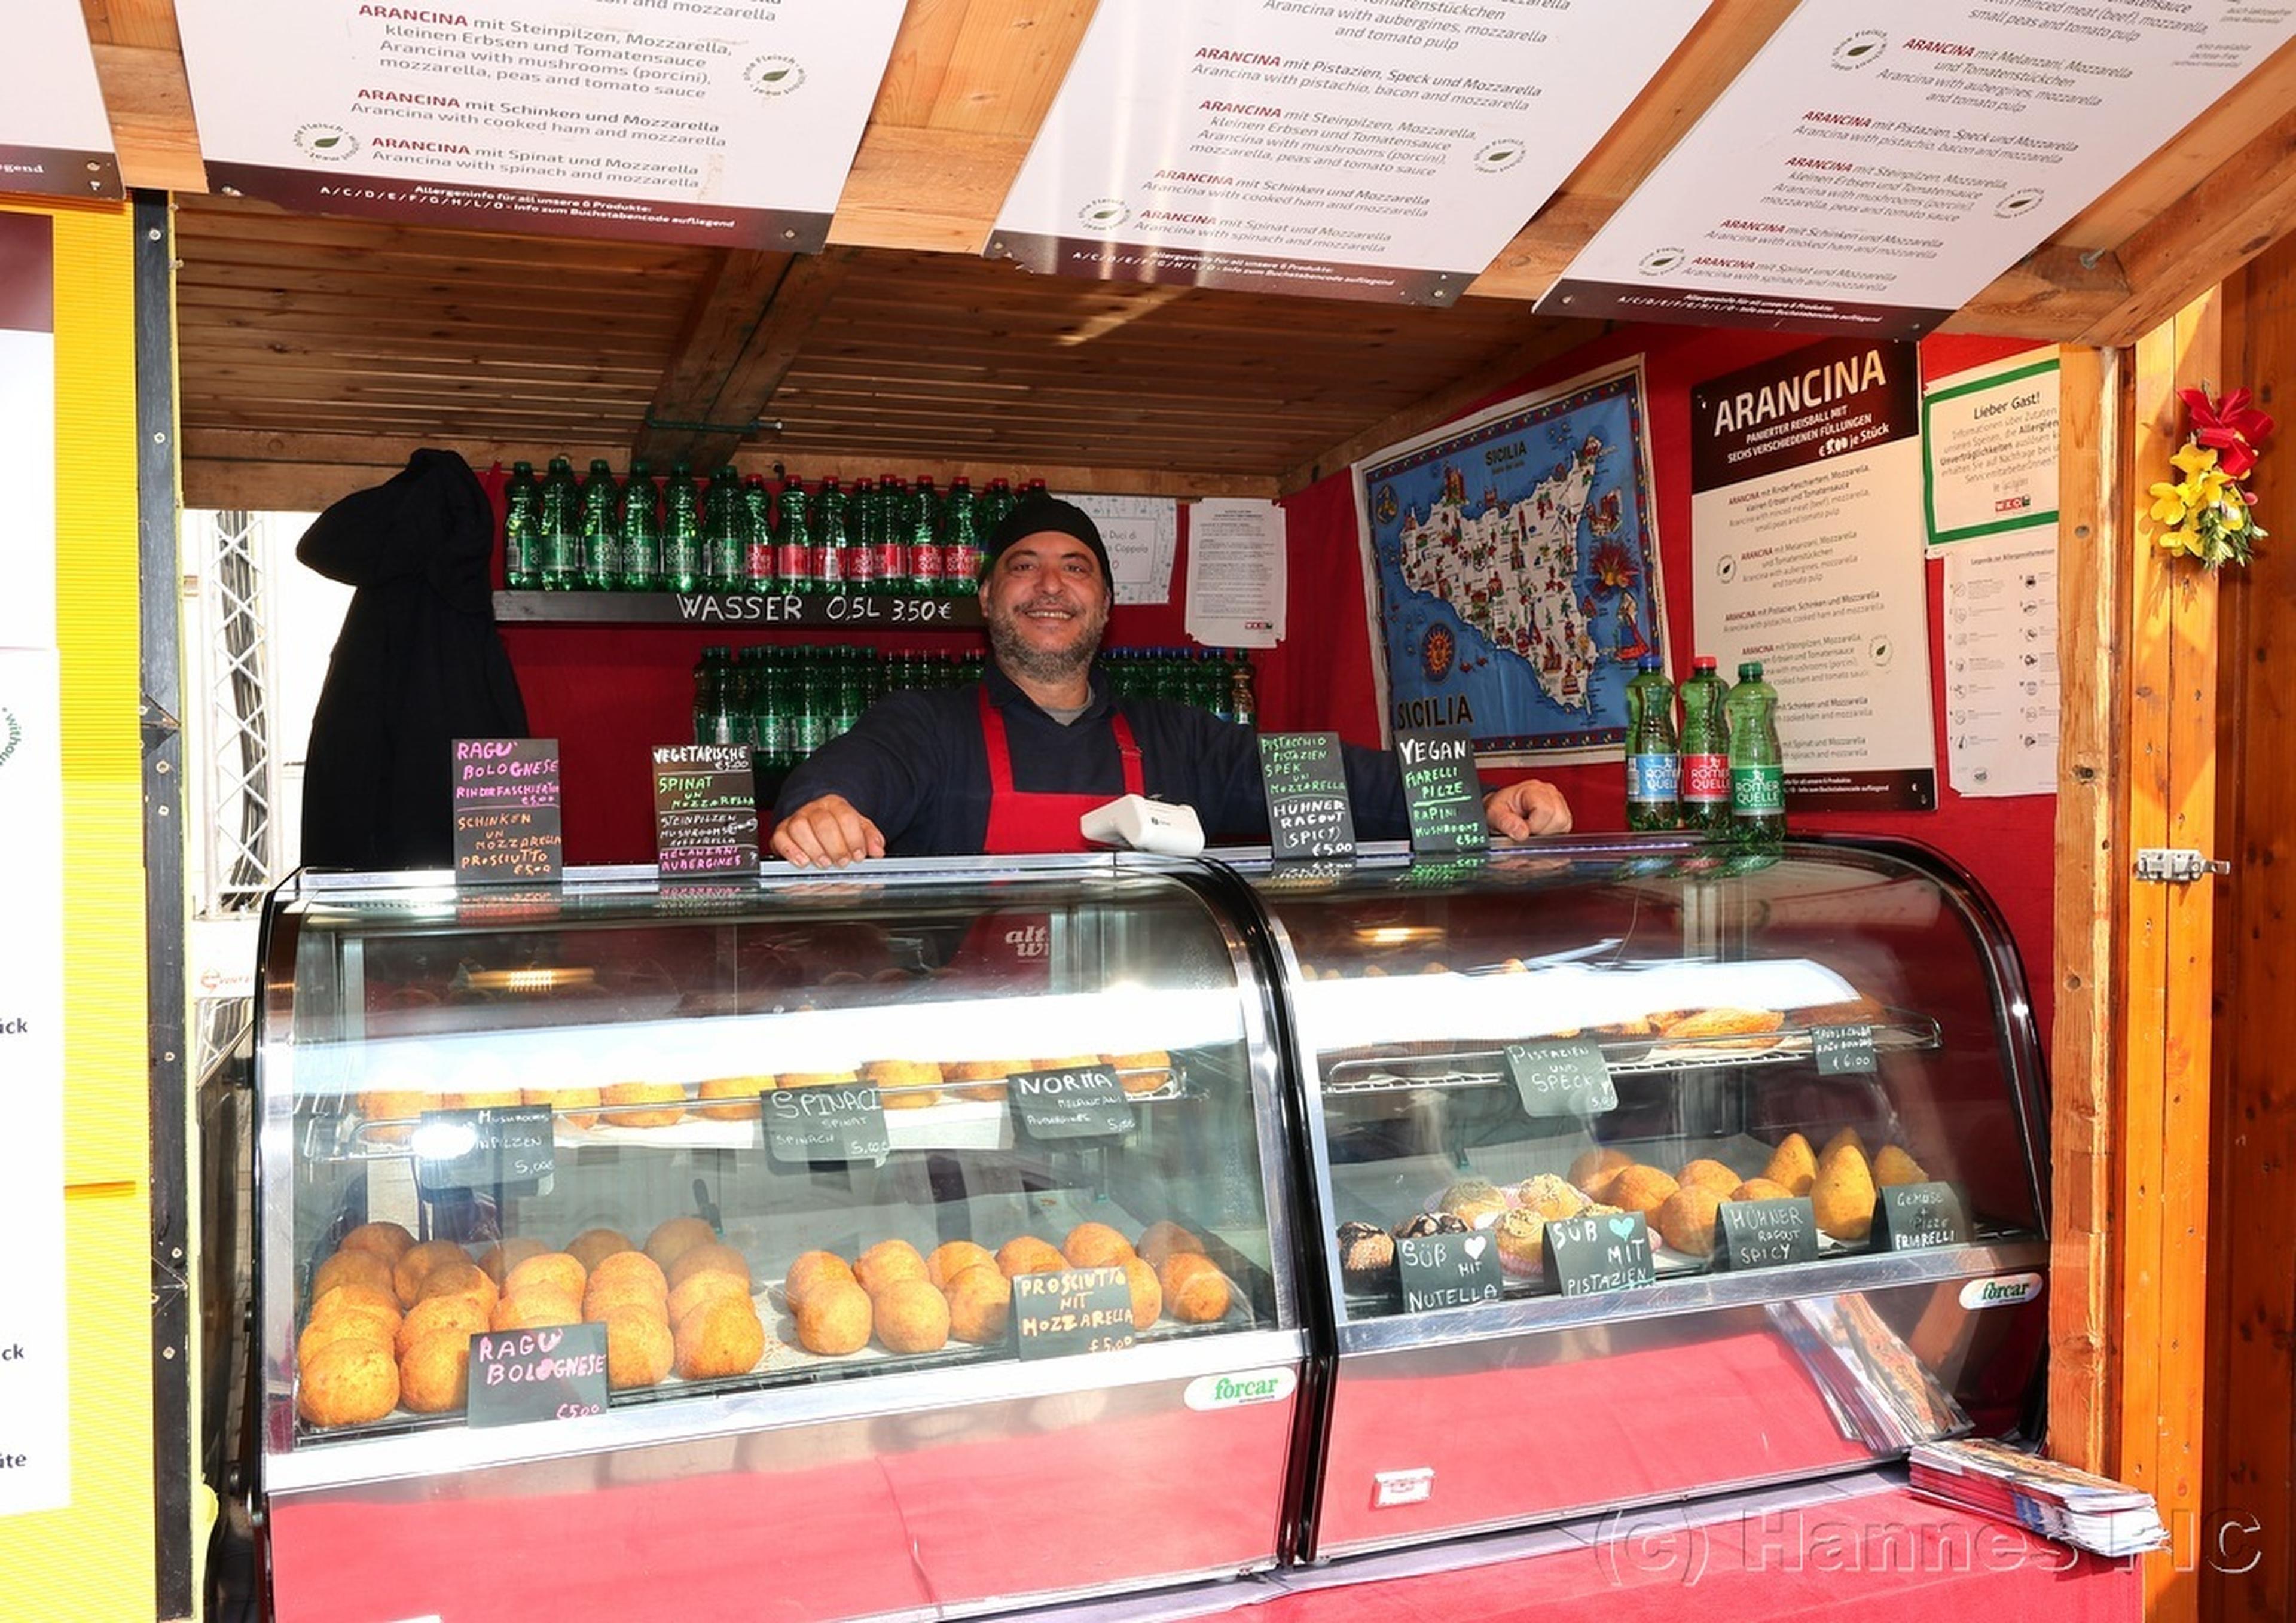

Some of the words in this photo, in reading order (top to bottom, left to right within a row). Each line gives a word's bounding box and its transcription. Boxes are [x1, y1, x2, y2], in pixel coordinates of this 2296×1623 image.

[672, 2, 777, 22] mozzarella
[359, 4, 468, 27] ARANCINA
[474, 20, 503, 30] mit
[511, 20, 620, 44] Steinpilzen,
[626, 33, 731, 56] Mozzarella,
[386, 24, 456, 42] kleinen
[462, 32, 528, 49] Erbsen
[533, 43, 569, 54] und
[574, 44, 706, 68] Tomatensauce
[380, 40, 466, 59] Arancina
[471, 51, 513, 64] with
[518, 57, 628, 75] mushrooms
[633, 66, 712, 86] (porcini),
[1194, 47, 1281, 67] ARANCINA
[1283, 60, 1309, 70] mit
[1312, 60, 1382, 80] Pistazien,
[1388, 69, 1428, 84] Speck
[1432, 78, 1463, 87] und
[1463, 78, 1542, 96] Mozzarella
[351, 102, 433, 120] Arancina
[438, 114, 479, 124] with
[483, 118, 547, 131] cooked
[552, 122, 590, 135] ham
[594, 129, 627, 138] and
[631, 132, 726, 147] mozzarella
[357, 89, 460, 108] ARANCINA
[466, 102, 494, 111] mit
[500, 103, 581, 119] Schinken
[585, 114, 619, 123] und
[623, 114, 719, 132] Mozzarella
[371, 137, 471, 155] ARANCINA
[509, 150, 563, 163] Spinat
[569, 158, 601, 166] und
[606, 158, 698, 175] Mozzarella
[372, 150, 451, 167] Arancina
[456, 160, 495, 170] with
[500, 164, 567, 177] spinach
[570, 171, 603, 180] and
[606, 174, 699, 188] mozzarella
[1714, 349, 1886, 438] ARANCINA
[1974, 401, 2008, 420] Lieber
[2011, 391, 2041, 410] Gast!
[1745, 421, 1790, 444] PANIERTER
[1790, 412, 1830, 432] REISBALL
[1830, 405, 1848, 420] MIT
[1849, 433, 1860, 449] je
[1860, 422, 1889, 443] Stück
[1727, 447, 1752, 465] SECHS
[1752, 430, 1819, 457] VERSCHIEDENEN
[1819, 413, 1872, 437] FÜLLUNGEN
[676, 594, 804, 621] WASSER
[1397, 694, 1474, 731] SICILIA
[653, 746, 748, 764] VEGETARISCHE
[1399, 738, 1466, 765] VEGAN
[462, 759, 559, 780] BOLOGNESE
[658, 776, 713, 794] SPINAT
[1421, 781, 1463, 799] PILZE
[1736, 791, 1780, 805] QUELLE
[1274, 799, 1346, 817] HÜHNER
[661, 855, 742, 871] AUBERGINES
[771, 1090, 882, 1119] SPINACI
[1607, 1238, 1645, 1265] MIT
[1740, 1244, 1791, 1265] SPICY
[1020, 1265, 1127, 1298] PROSCIUTTO
[1458, 1261, 1483, 1278] MIT
[1567, 1268, 1647, 1296] PISTAZIEN
[1408, 1283, 1498, 1313] NUTELLA
[1981, 1281, 2029, 1300] forcar
[486, 1353, 607, 1386] BOLOGNESE
[1215, 1377, 1278, 1401] forcar
